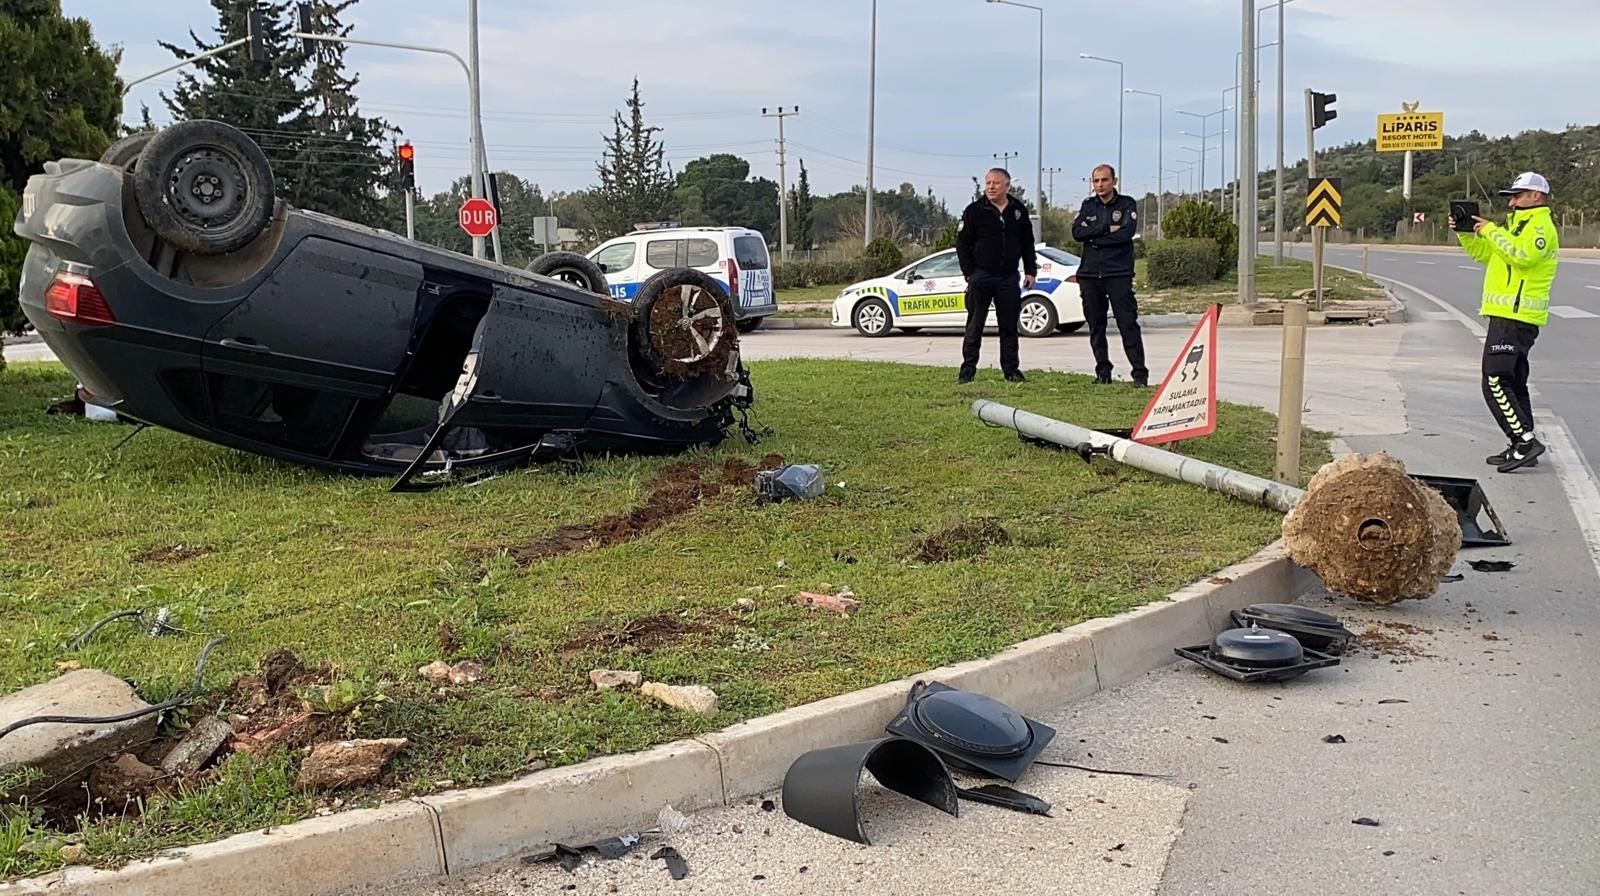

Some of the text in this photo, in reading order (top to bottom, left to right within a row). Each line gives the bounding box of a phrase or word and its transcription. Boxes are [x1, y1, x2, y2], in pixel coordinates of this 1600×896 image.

[462, 210, 494, 225] DUR
[609, 285, 627, 298] LİS
[903, 296, 958, 311] TRAFİK POLİSİ
[1169, 387, 1198, 400] SULAMA
[1153, 397, 1207, 416] YAPILMAKTADIR
